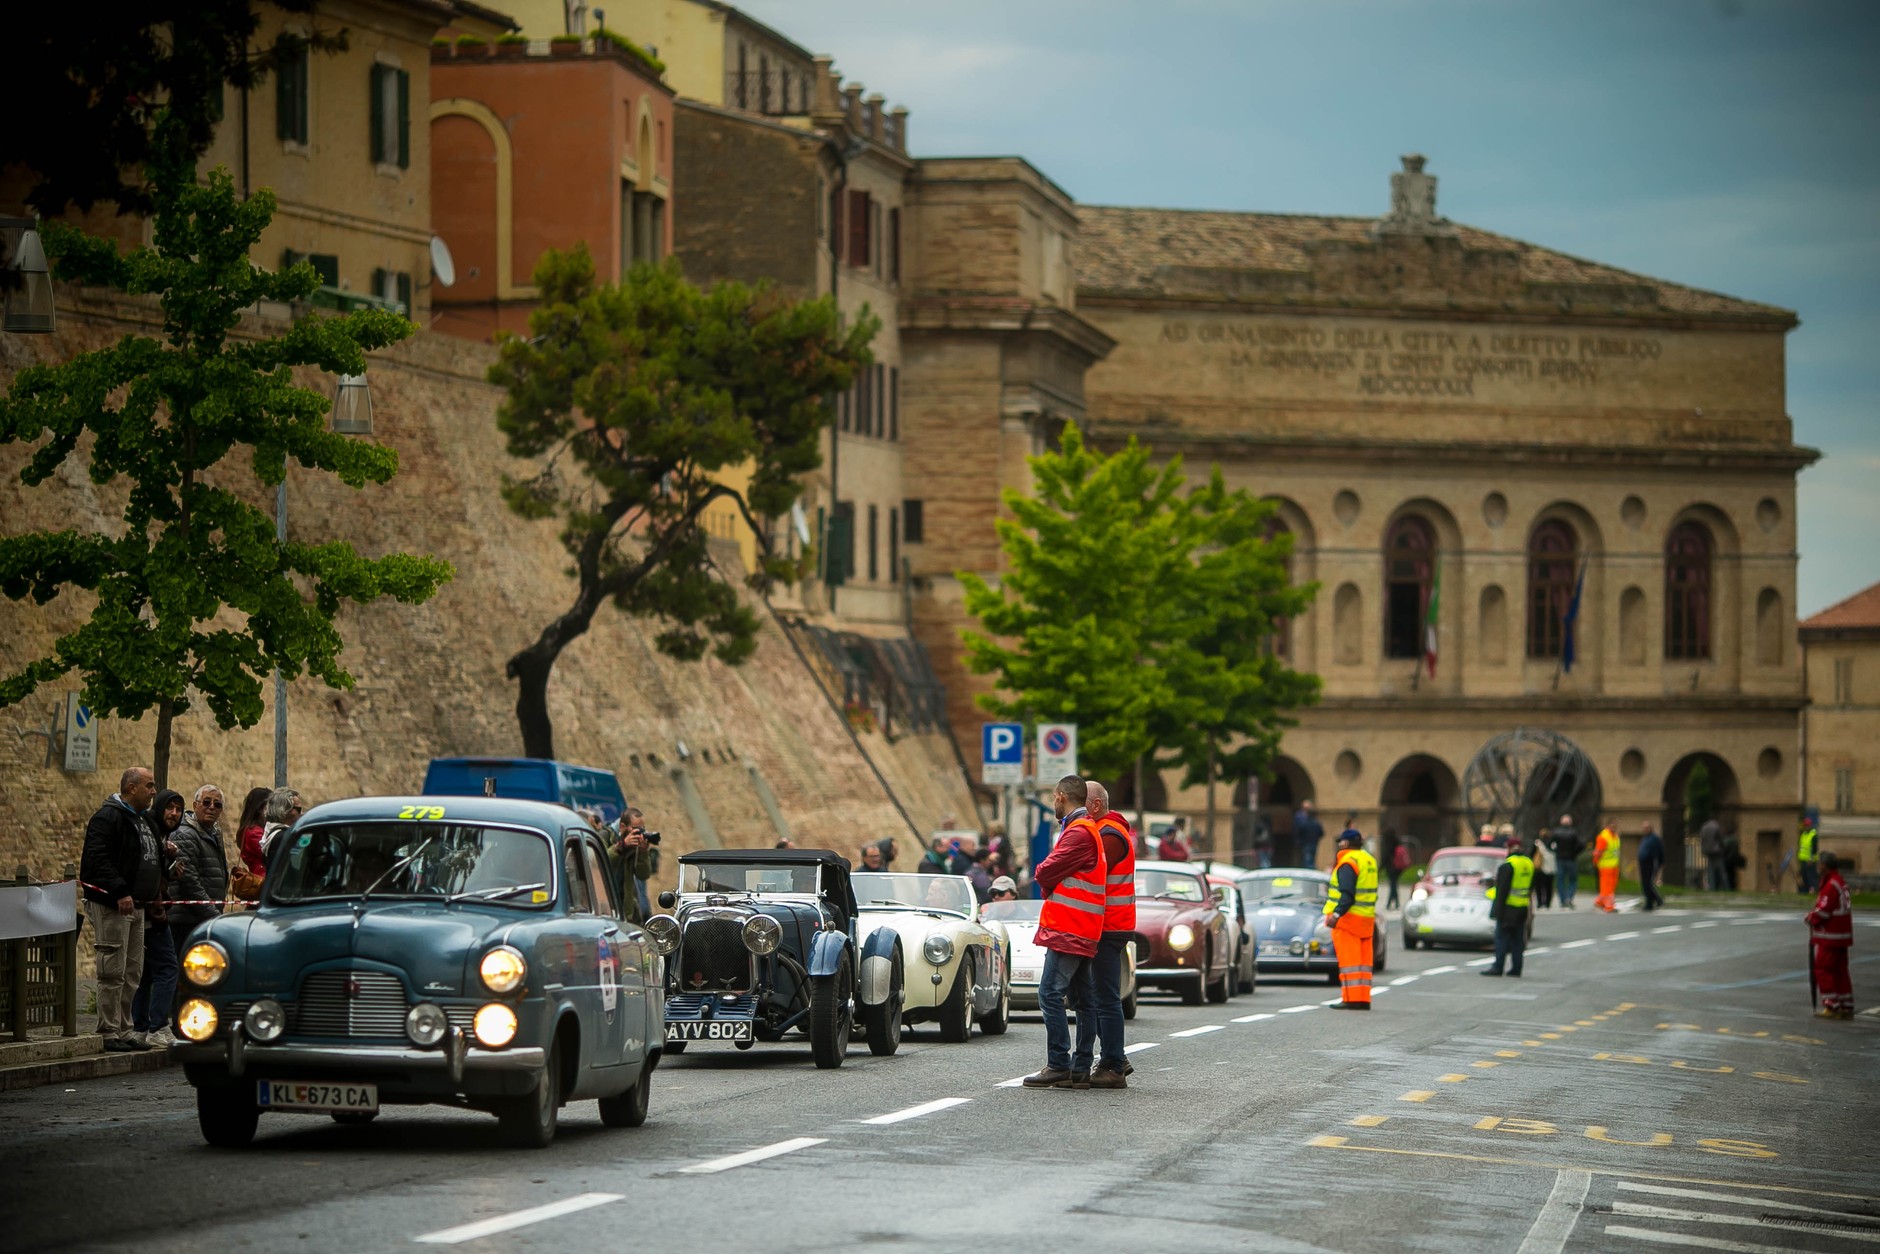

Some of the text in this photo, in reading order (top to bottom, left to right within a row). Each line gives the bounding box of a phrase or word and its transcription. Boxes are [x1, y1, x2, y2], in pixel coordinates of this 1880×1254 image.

[1159, 321, 1189, 343] AD
[1334, 326, 1393, 350] DELLA
[1466, 332, 1482, 353] A
[990, 727, 1015, 761] P
[398, 805, 446, 820] 279
[667, 1022, 747, 1039] AYV 802
[1590, 1052, 1811, 1084] BUS
[273, 1084, 371, 1106] KL 673 CA
[1473, 1115, 1780, 1158] BUS
